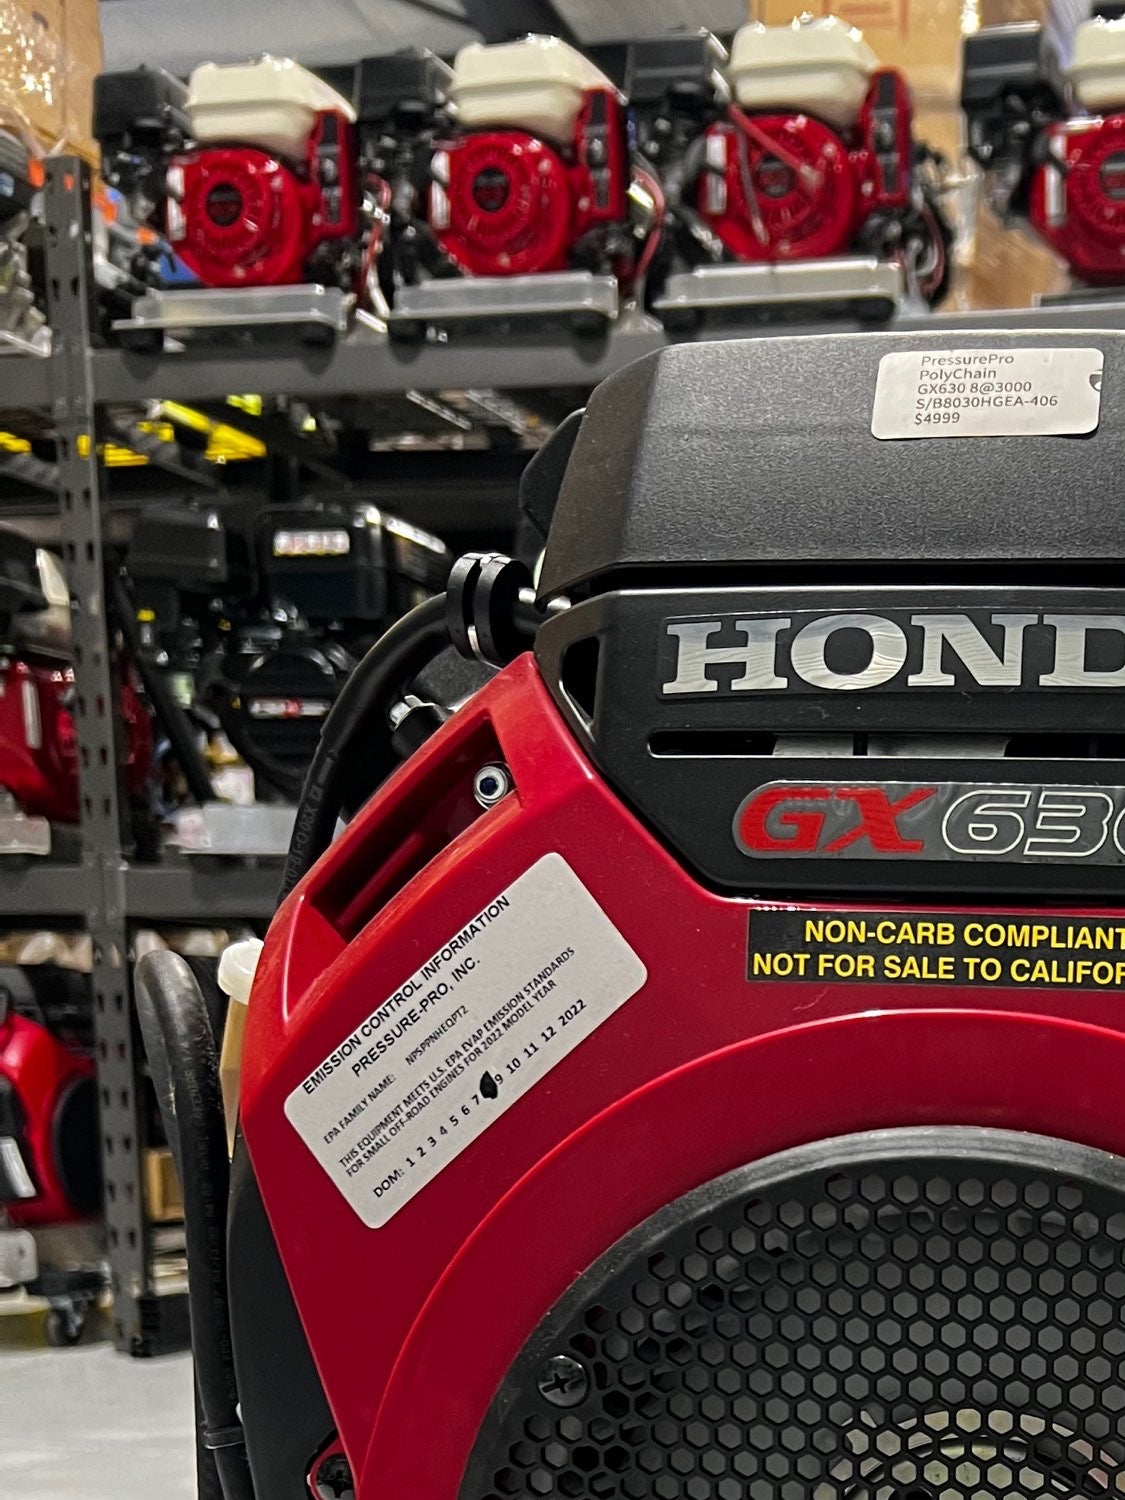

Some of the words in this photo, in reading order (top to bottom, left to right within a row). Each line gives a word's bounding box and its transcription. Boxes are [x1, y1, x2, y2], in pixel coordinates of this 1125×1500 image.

[919, 368, 997, 382] PolyChain
[921, 354, 1015, 367] PressurePro
[915, 396, 1058, 410] S/B8030HGEA-406
[917, 383, 966, 396] GX630
[969, 382, 1032, 395] 8@3000
[914, 412, 960, 426] $4999
[738, 787, 936, 854] GX
[805, 920, 955, 946] NON-CARB
[752, 953, 810, 979] NOT
[819, 955, 874, 980] FOR
[884, 956, 954, 981] SALE
[962, 958, 1003, 982] TO
[302, 1035, 362, 1095] EMISSION
[361, 980, 423, 1038] CONTROL
[420, 895, 510, 982] INFORMATION
[351, 982, 454, 1078] PRESSURE-PRO,
[451, 956, 481, 983] INC.
[338, 1147, 359, 1168] THIS
[356, 1103, 404, 1151] EQUIPMENT
[402, 1079, 431, 1108] MEETS
[428, 1066, 448, 1083] U.S.
[444, 1049, 464, 1068] EPA
[460, 1028, 484, 1053] EVAP
[482, 991, 526, 1033] EMISSION
[522, 947, 575, 996] STANDARDS
[345, 1158, 366, 1178] FOR
[362, 1134, 391, 1162] SMALL
[388, 1095, 431, 1137] OFF-ROAD
[428, 1063, 465, 1099] ENGINES
[463, 1046, 484, 1067] FOR
[480, 1027, 504, 1051] 2022
[501, 1000, 535, 1032] MODEL
[531, 979, 557, 1002] YEAR
[323, 1127, 342, 1145] EPA
[338, 1097, 369, 1130] FAMILY
[367, 1074, 396, 1102] NAME:
[372, 1168, 405, 1198] DOM:
[405, 1157, 416, 1168] 1
[416, 1146, 427, 1158] 2
[427, 1135, 437, 1148] 3
[439, 1125, 448, 1136] 4
[448, 1114, 459, 1127] 5
[460, 1104, 471, 1116] 6
[470, 1093, 480, 1106] 7
[494, 1073, 504, 1085] 9
[505, 1057, 522, 1075] 10
[523, 1042, 540, 1059] 11
[540, 1025, 557, 1043] 12
[557, 998, 587, 1027] 2022
